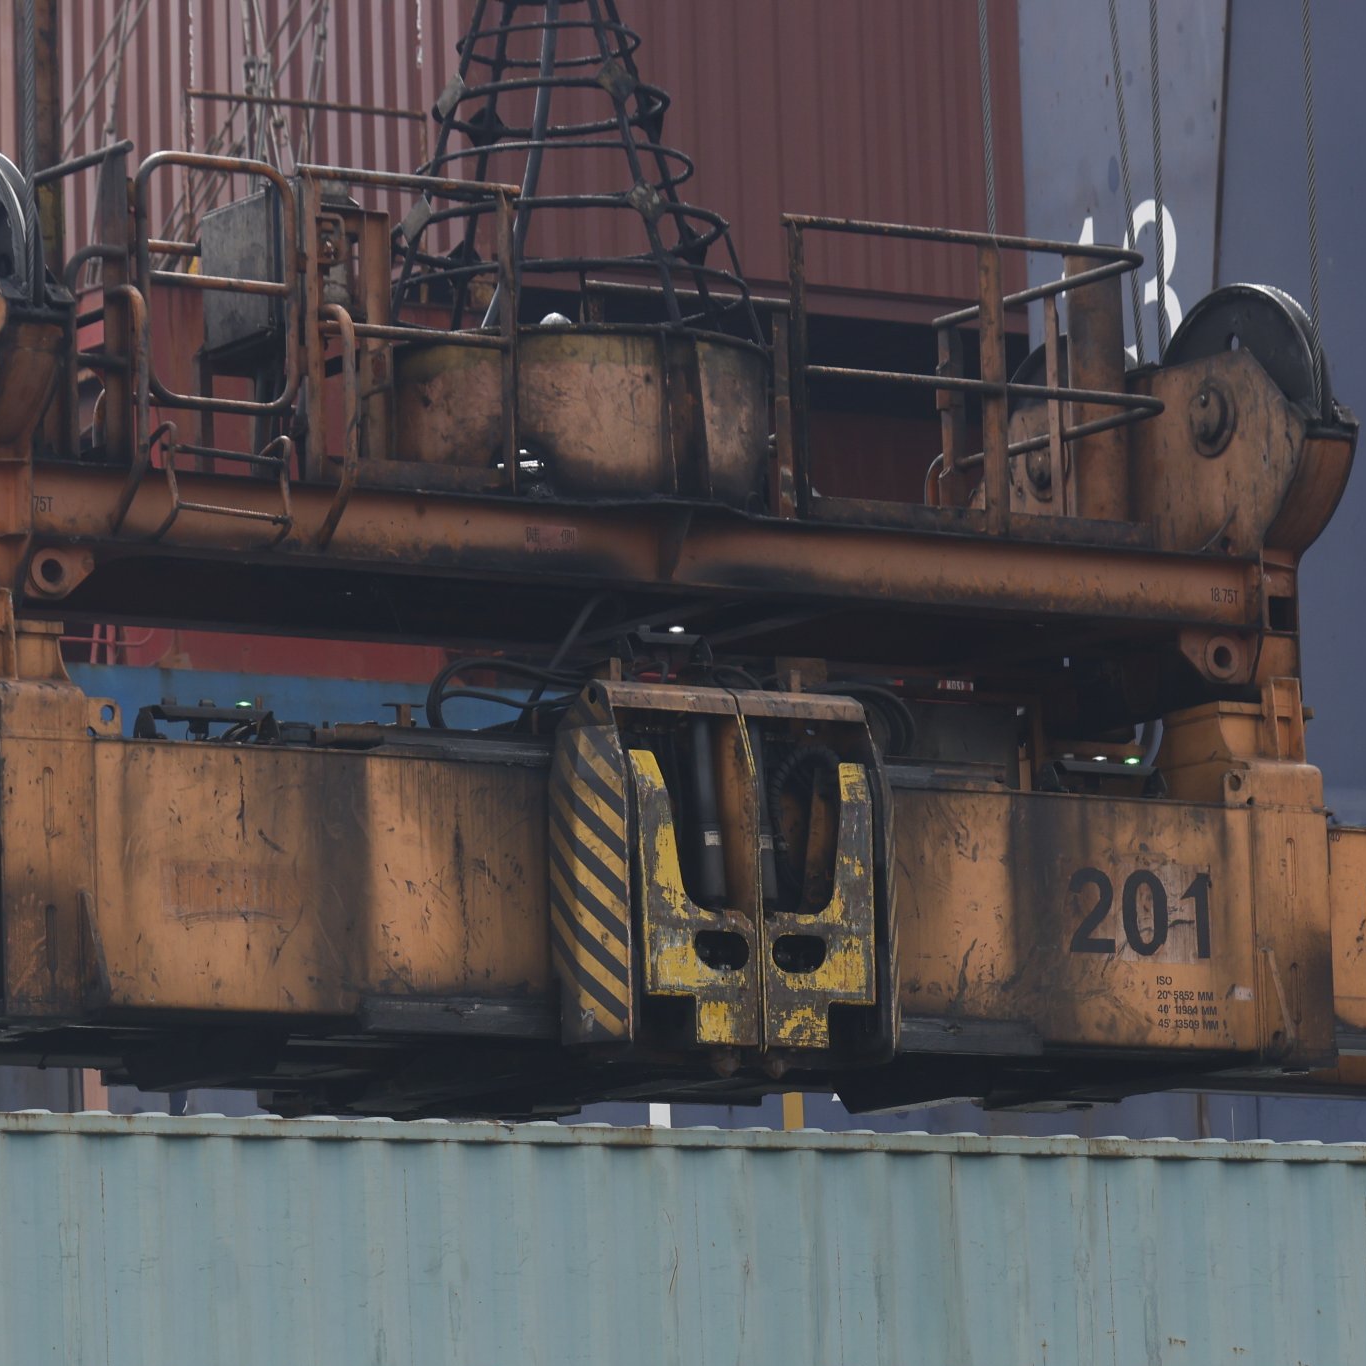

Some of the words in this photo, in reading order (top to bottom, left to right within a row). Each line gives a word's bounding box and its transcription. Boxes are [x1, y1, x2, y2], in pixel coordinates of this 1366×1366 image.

[1068, 866, 1212, 959] 201
[1156, 975, 1173, 986] ISO
[1173, 990, 1195, 1001] 5852
[1197, 991, 1214, 1001] MM
[1201, 1006, 1217, 1016] MM
[1174, 1019, 1200, 1029] 13509
[1202, 1020, 1219, 1030] MM
